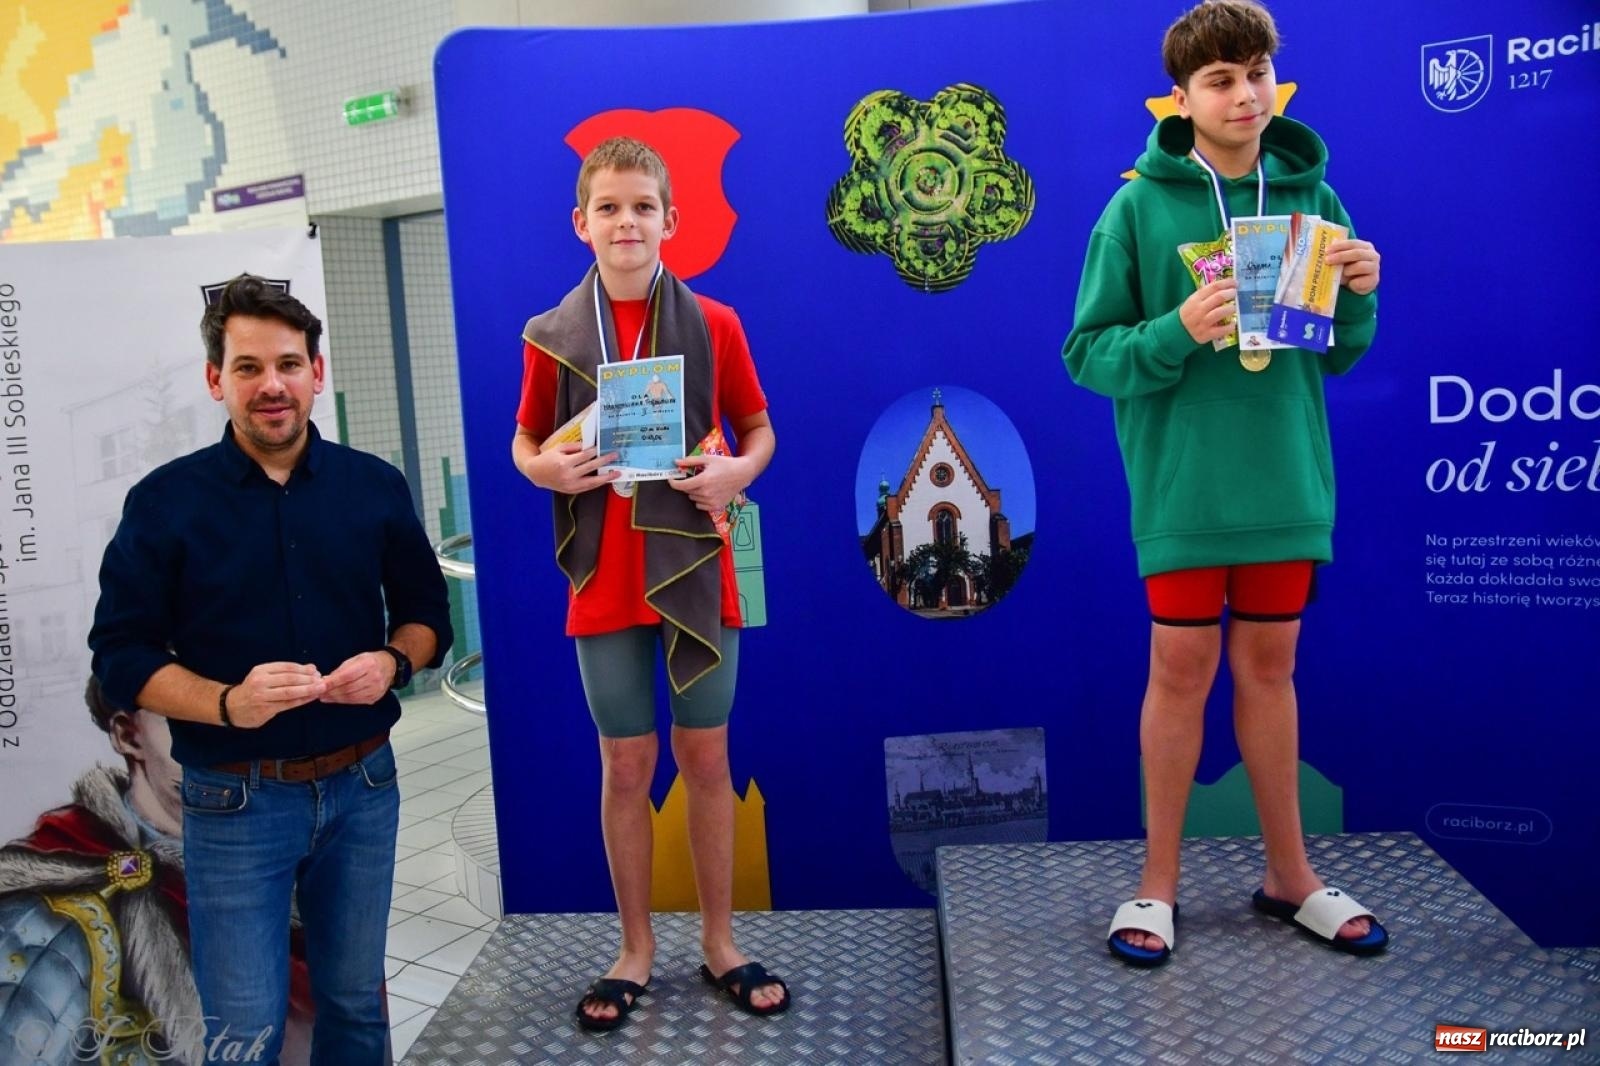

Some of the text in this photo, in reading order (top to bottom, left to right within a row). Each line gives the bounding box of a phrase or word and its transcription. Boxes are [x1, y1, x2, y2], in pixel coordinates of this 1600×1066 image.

[1509, 69, 1553, 90] 1217
[1308, 285, 1317, 303] BON
[0, 283, 26, 427] Sobieskiego
[602, 363, 680, 380] DYPLOM
[6, 436, 28, 454] III
[1425, 440, 1497, 493] od
[12, 464, 35, 519] Jana
[15, 526, 38, 562] im.
[1425, 534, 1448, 547] Na
[1452, 534, 1541, 549] przestrzeni
[1425, 554, 1447, 568] się
[1451, 553, 1486, 569] tutaj
[1490, 556, 1509, 567] ze
[1513, 554, 1554, 569] sobą
[1426, 572, 1475, 585] Każda
[1479, 572, 1564, 586] dokładała
[1425, 591, 1469, 605] Teraz
[1473, 592, 1531, 608] historię
[2, 736, 20, 749] z
[1443, 816, 1533, 835] raciborz.pl
